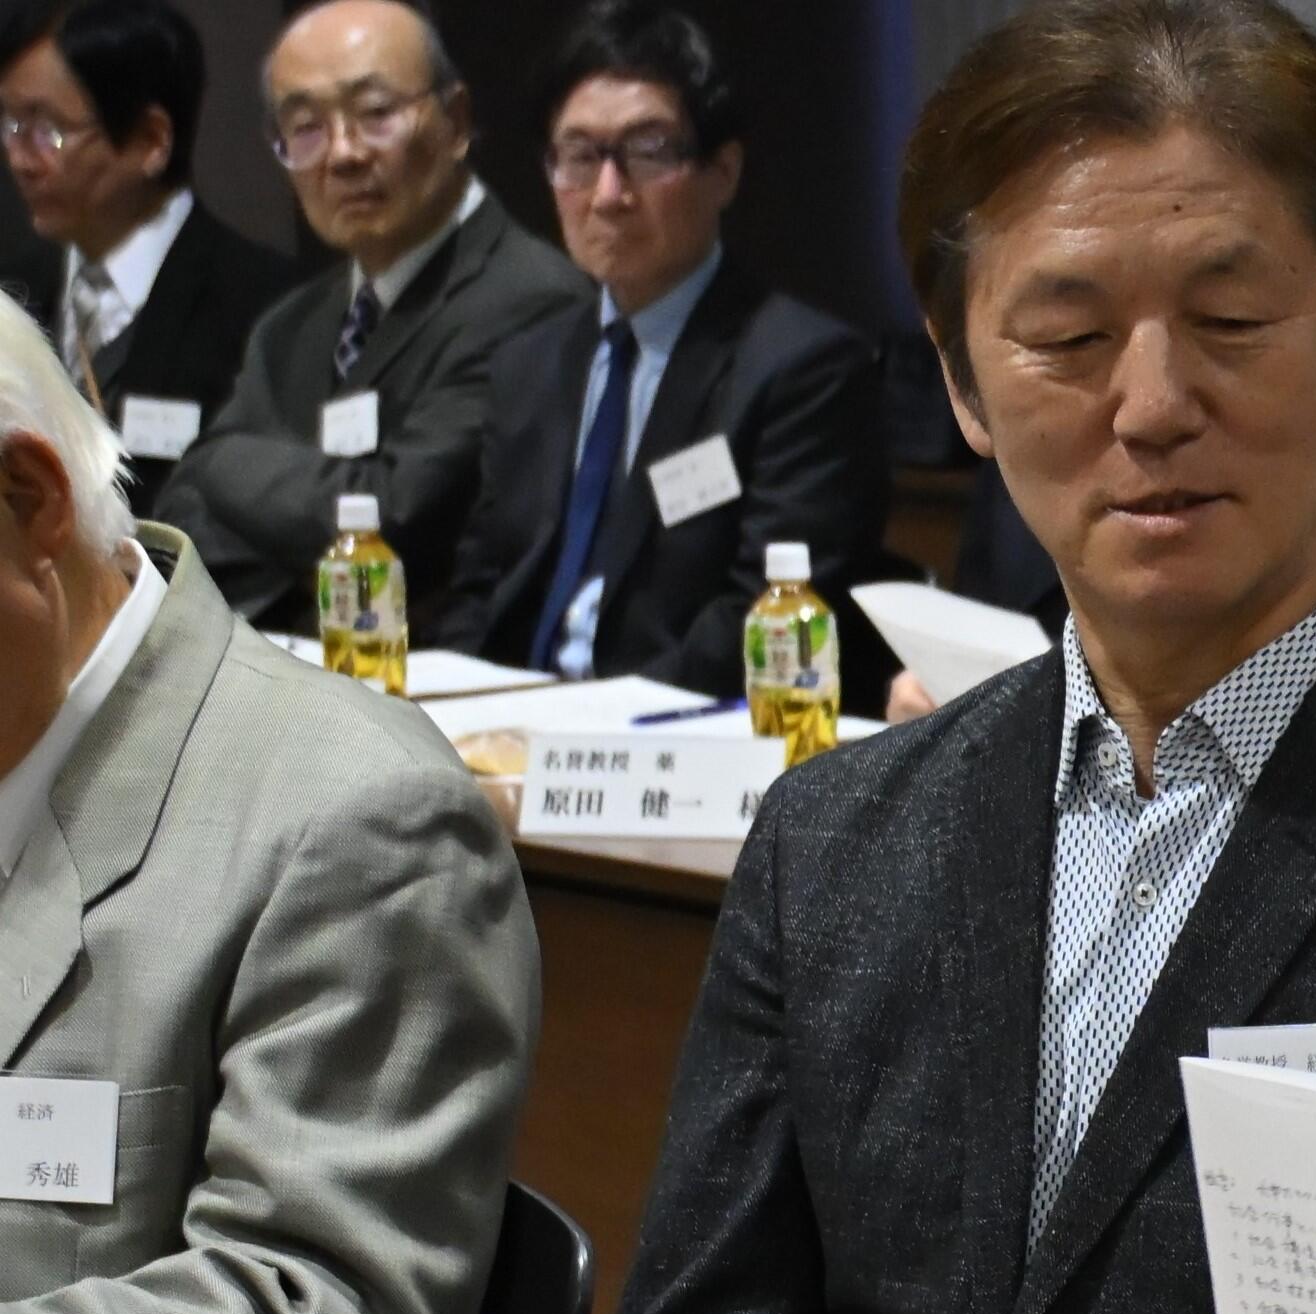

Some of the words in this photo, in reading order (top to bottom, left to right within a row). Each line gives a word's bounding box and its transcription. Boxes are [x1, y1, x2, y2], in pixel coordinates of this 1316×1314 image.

[544, 750, 630, 773] 名誉教授
[542, 788, 604, 817] 原田
[640, 787, 703, 819] 健一
[16, 1103, 55, 1121] 経済
[26, 1161, 81, 1188] 秀雄
